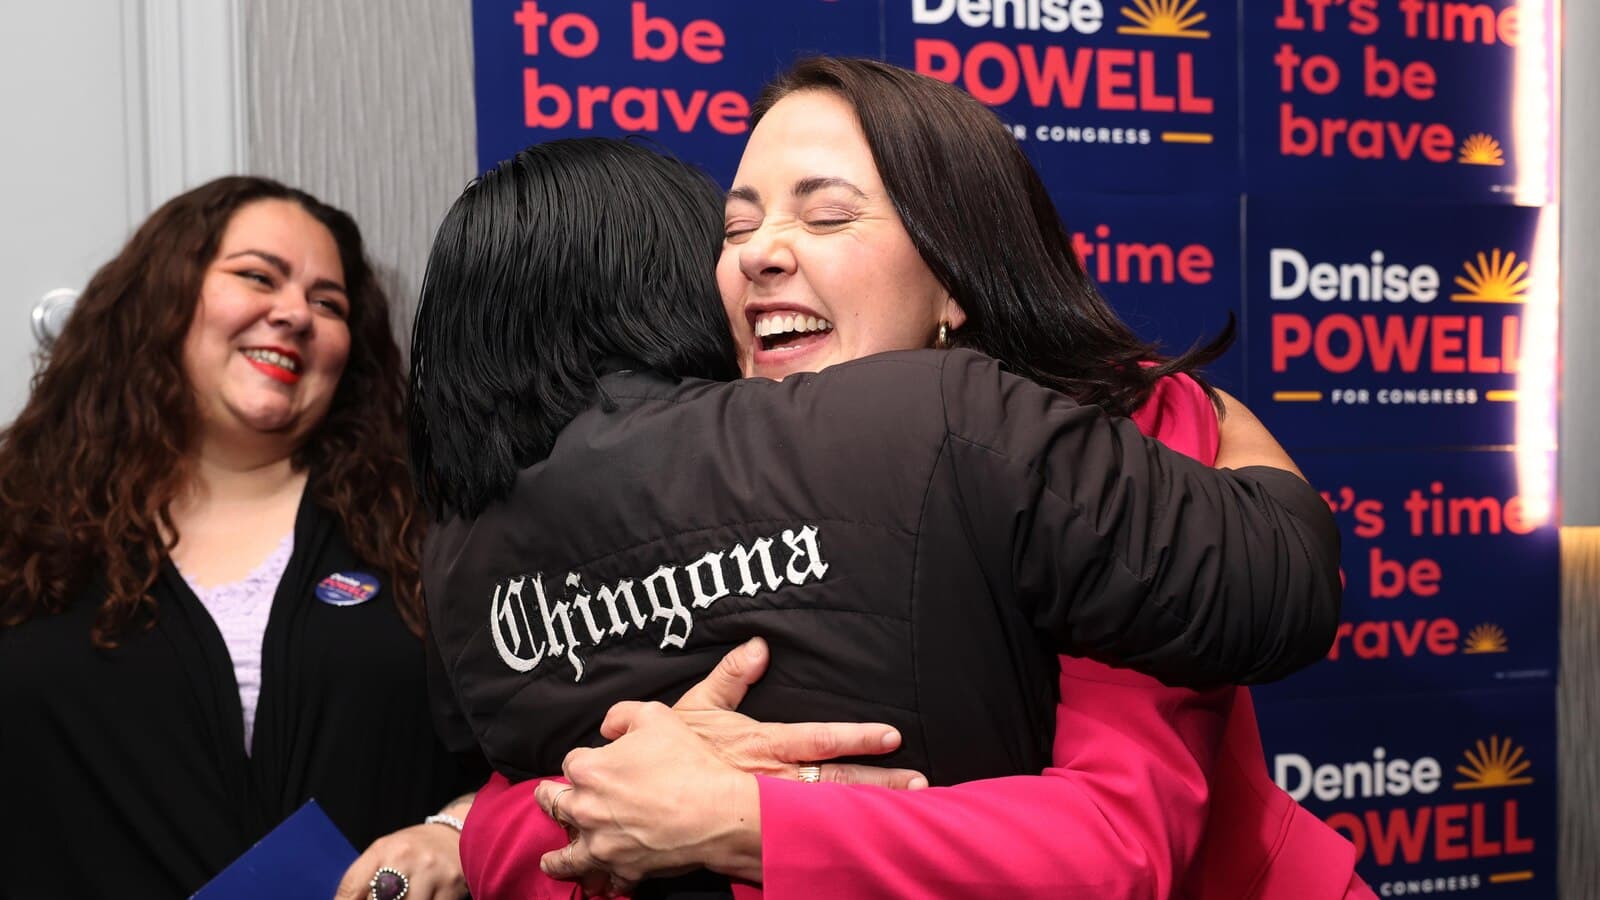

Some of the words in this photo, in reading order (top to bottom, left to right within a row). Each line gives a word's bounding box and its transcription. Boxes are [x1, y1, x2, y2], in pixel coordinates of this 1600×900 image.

[514, 0, 600, 59] to
[631, 1, 726, 64] be
[911, 0, 1105, 35] Denise
[1275, 0, 1381, 36] It's
[914, 37, 1215, 115] POWELL
[1274, 44, 1341, 95] to
[1364, 45, 1438, 101] be
[522, 67, 750, 136] brave
[1036, 125, 1152, 145] CONGRESS
[1280, 103, 1456, 163] brave
[1269, 248, 1441, 303] Denise
[1331, 388, 1371, 405] FOR
[1376, 388, 1479, 405] CONGRESS
[1370, 547, 1442, 598] be
[490, 524, 830, 682] Chingona
[1327, 617, 1460, 661] rave
[1274, 747, 1442, 802] Denise
[1325, 799, 1535, 866] OWELL
[1380, 874, 1481, 897] CONGRESS
